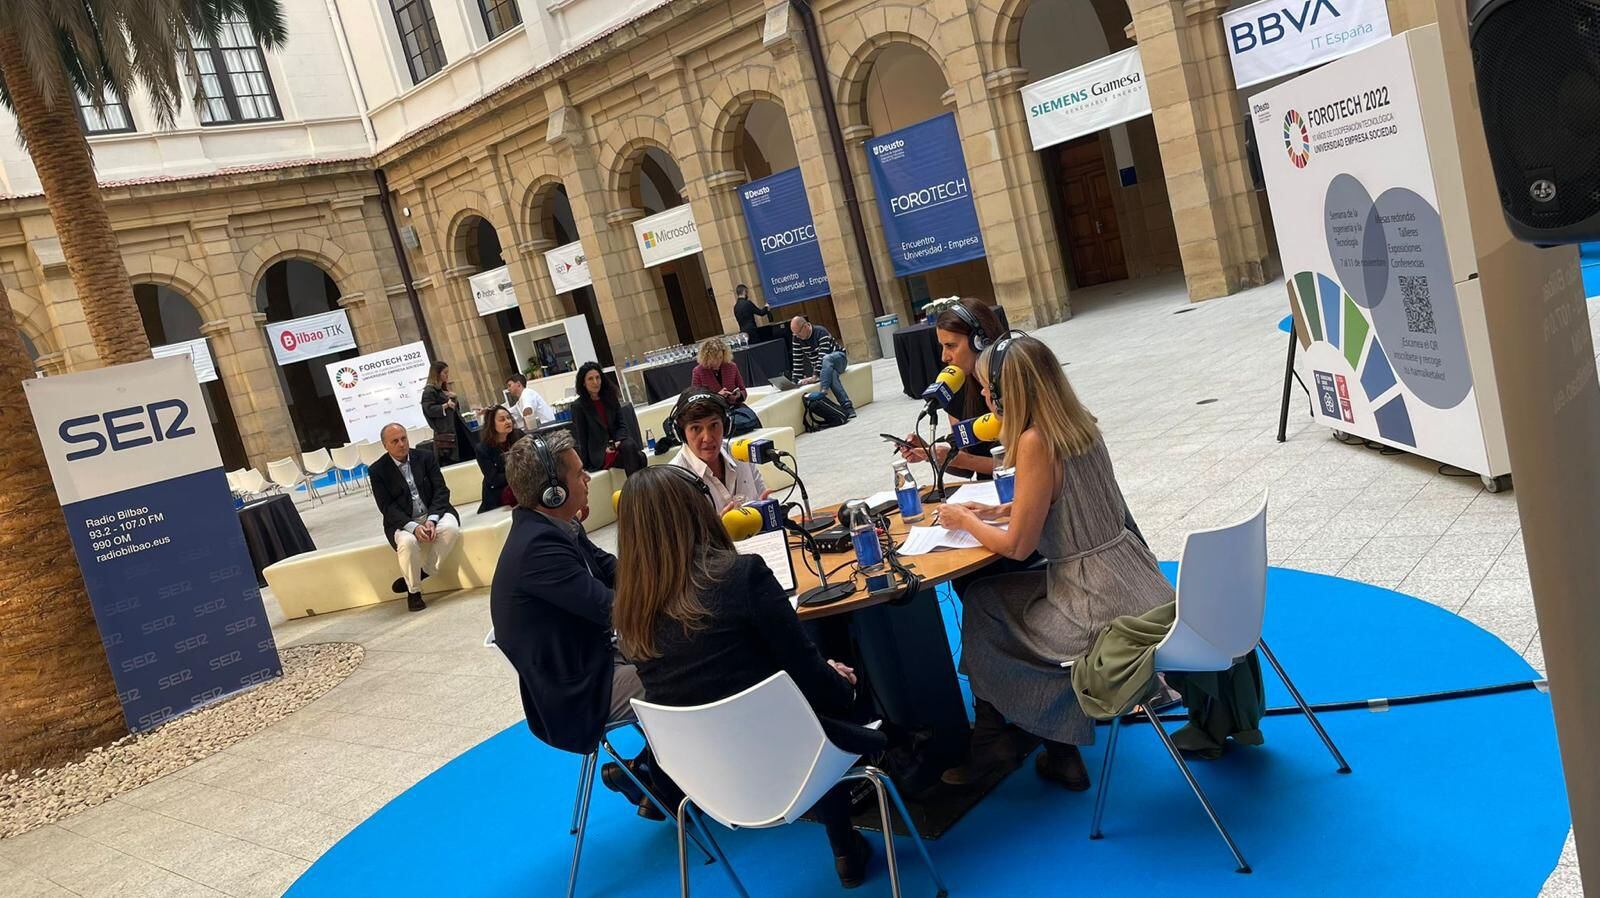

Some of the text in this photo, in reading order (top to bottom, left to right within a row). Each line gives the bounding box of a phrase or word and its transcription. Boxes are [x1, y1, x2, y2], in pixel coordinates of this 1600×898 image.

[1230, 0, 1341, 54] BBVA
[1310, 22, 1373, 50] IT España
[1031, 72, 1140, 117] SIEMENS Gamesa
[1307, 86, 1390, 128] FOROTECH 2022
[878, 139, 904, 153] Deusto
[1314, 124, 1397, 153] UNIVERSIDAD EMPRESA SOCIEDAD
[749, 186, 770, 198] Deusto
[890, 178, 967, 213] FOROTECH
[655, 219, 696, 243] Microsoft
[760, 224, 816, 252] FOROTEC
[901, 235, 935, 250] Encuentro
[1398, 227, 1418, 237] Talleres
[903, 243, 943, 260] Universidad
[948, 236, 978, 250] Empresa
[1388, 243, 1421, 253] Exposiciones
[1391, 258, 1424, 268] Conferencias
[771, 272, 799, 285] Encuentro
[774, 280, 805, 295] Universidad
[359, 356, 402, 372] FOROTECH
[403, 351, 421, 362] 2022
[59, 398, 196, 461] SER
[958, 424, 969, 445] SER
[85, 506, 148, 528] Radio Bilbao
[89, 526, 111, 540] 93.2
[120, 518, 146, 532] 107.0
[148, 512, 164, 524] FM
[767, 504, 777, 528] SER
[92, 533, 132, 551] 990 OM
[96, 536, 171, 562] radiobilbao.eus
[158, 668, 193, 690] SER
[138, 706, 175, 729] SER
